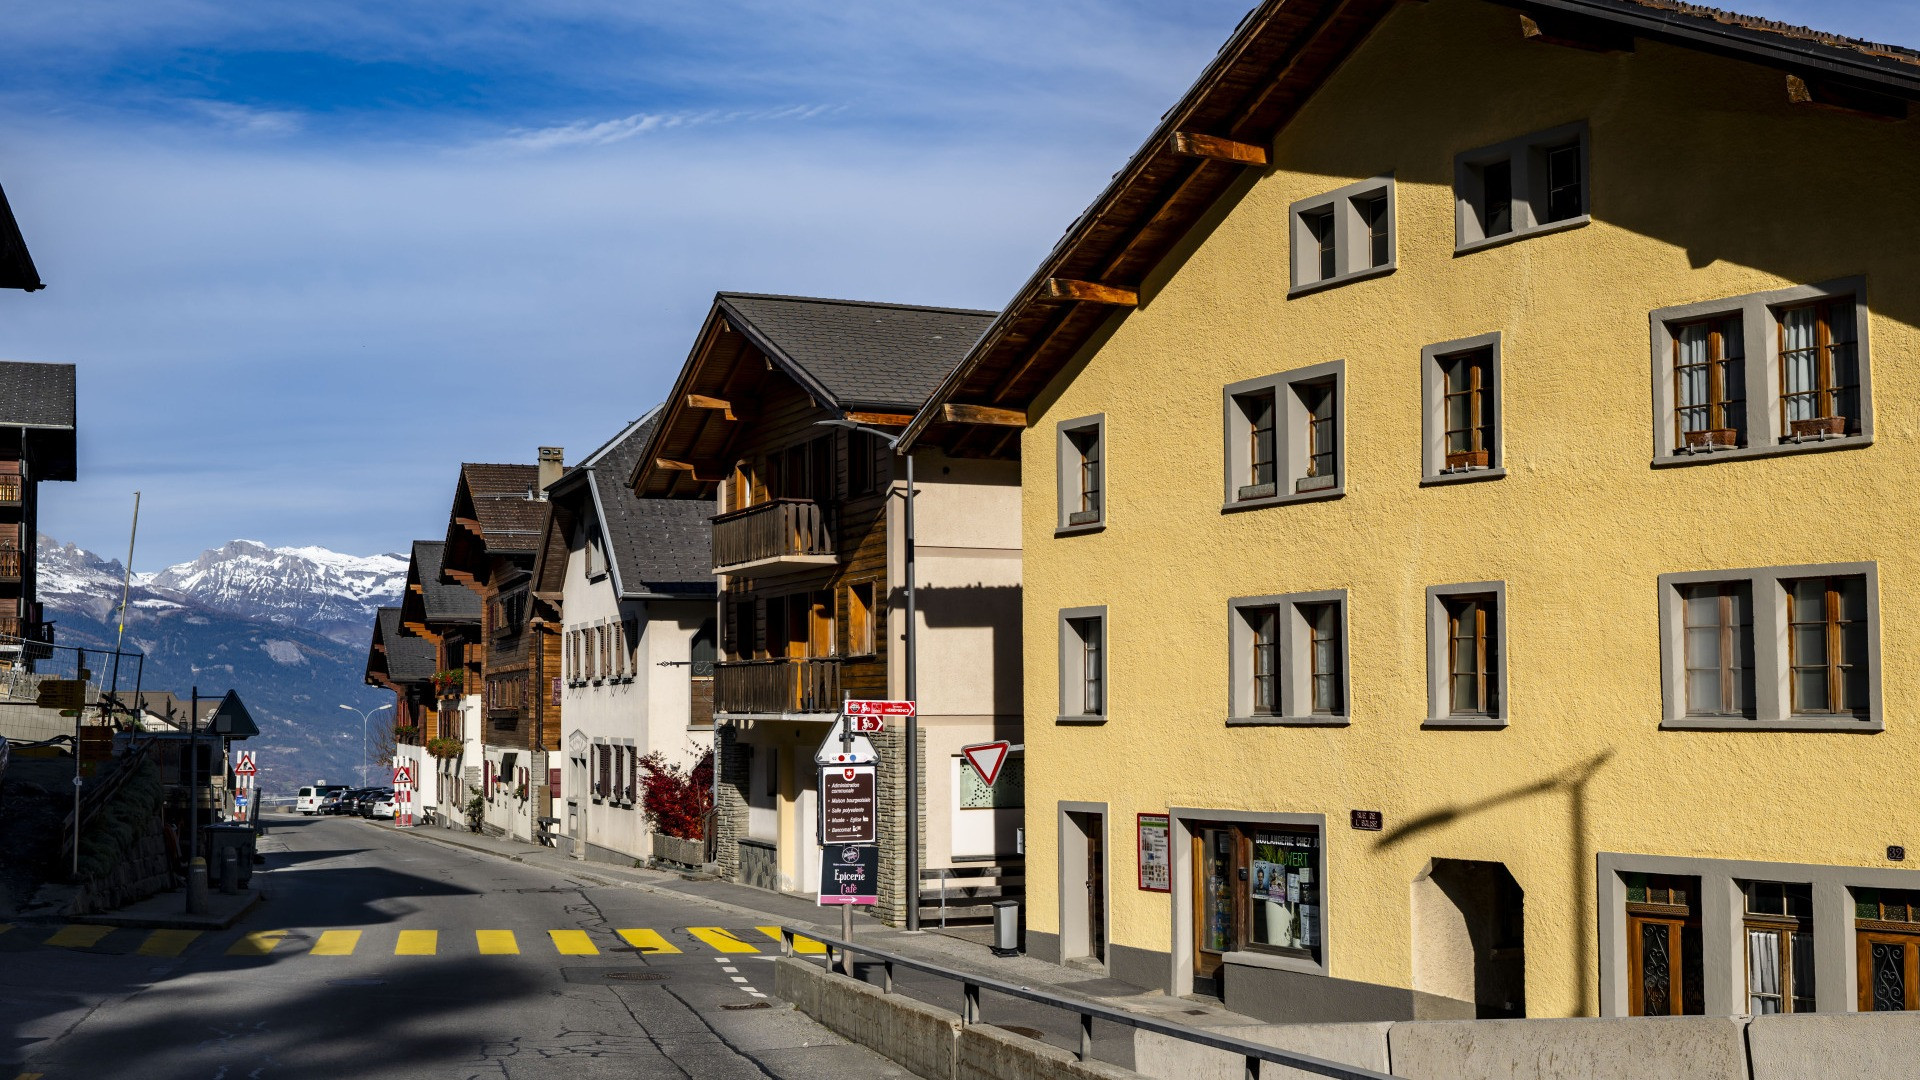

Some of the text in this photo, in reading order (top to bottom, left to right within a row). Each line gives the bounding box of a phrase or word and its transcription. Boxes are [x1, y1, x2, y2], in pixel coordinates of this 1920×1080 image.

[1255, 834, 1295, 846] BOULANGERIE
[1295, 836, 1312, 848] CHEZ
[1889, 847, 1903, 859] 32
[834, 868, 866, 883] Epicerie
[840, 883, 858, 895] Café
